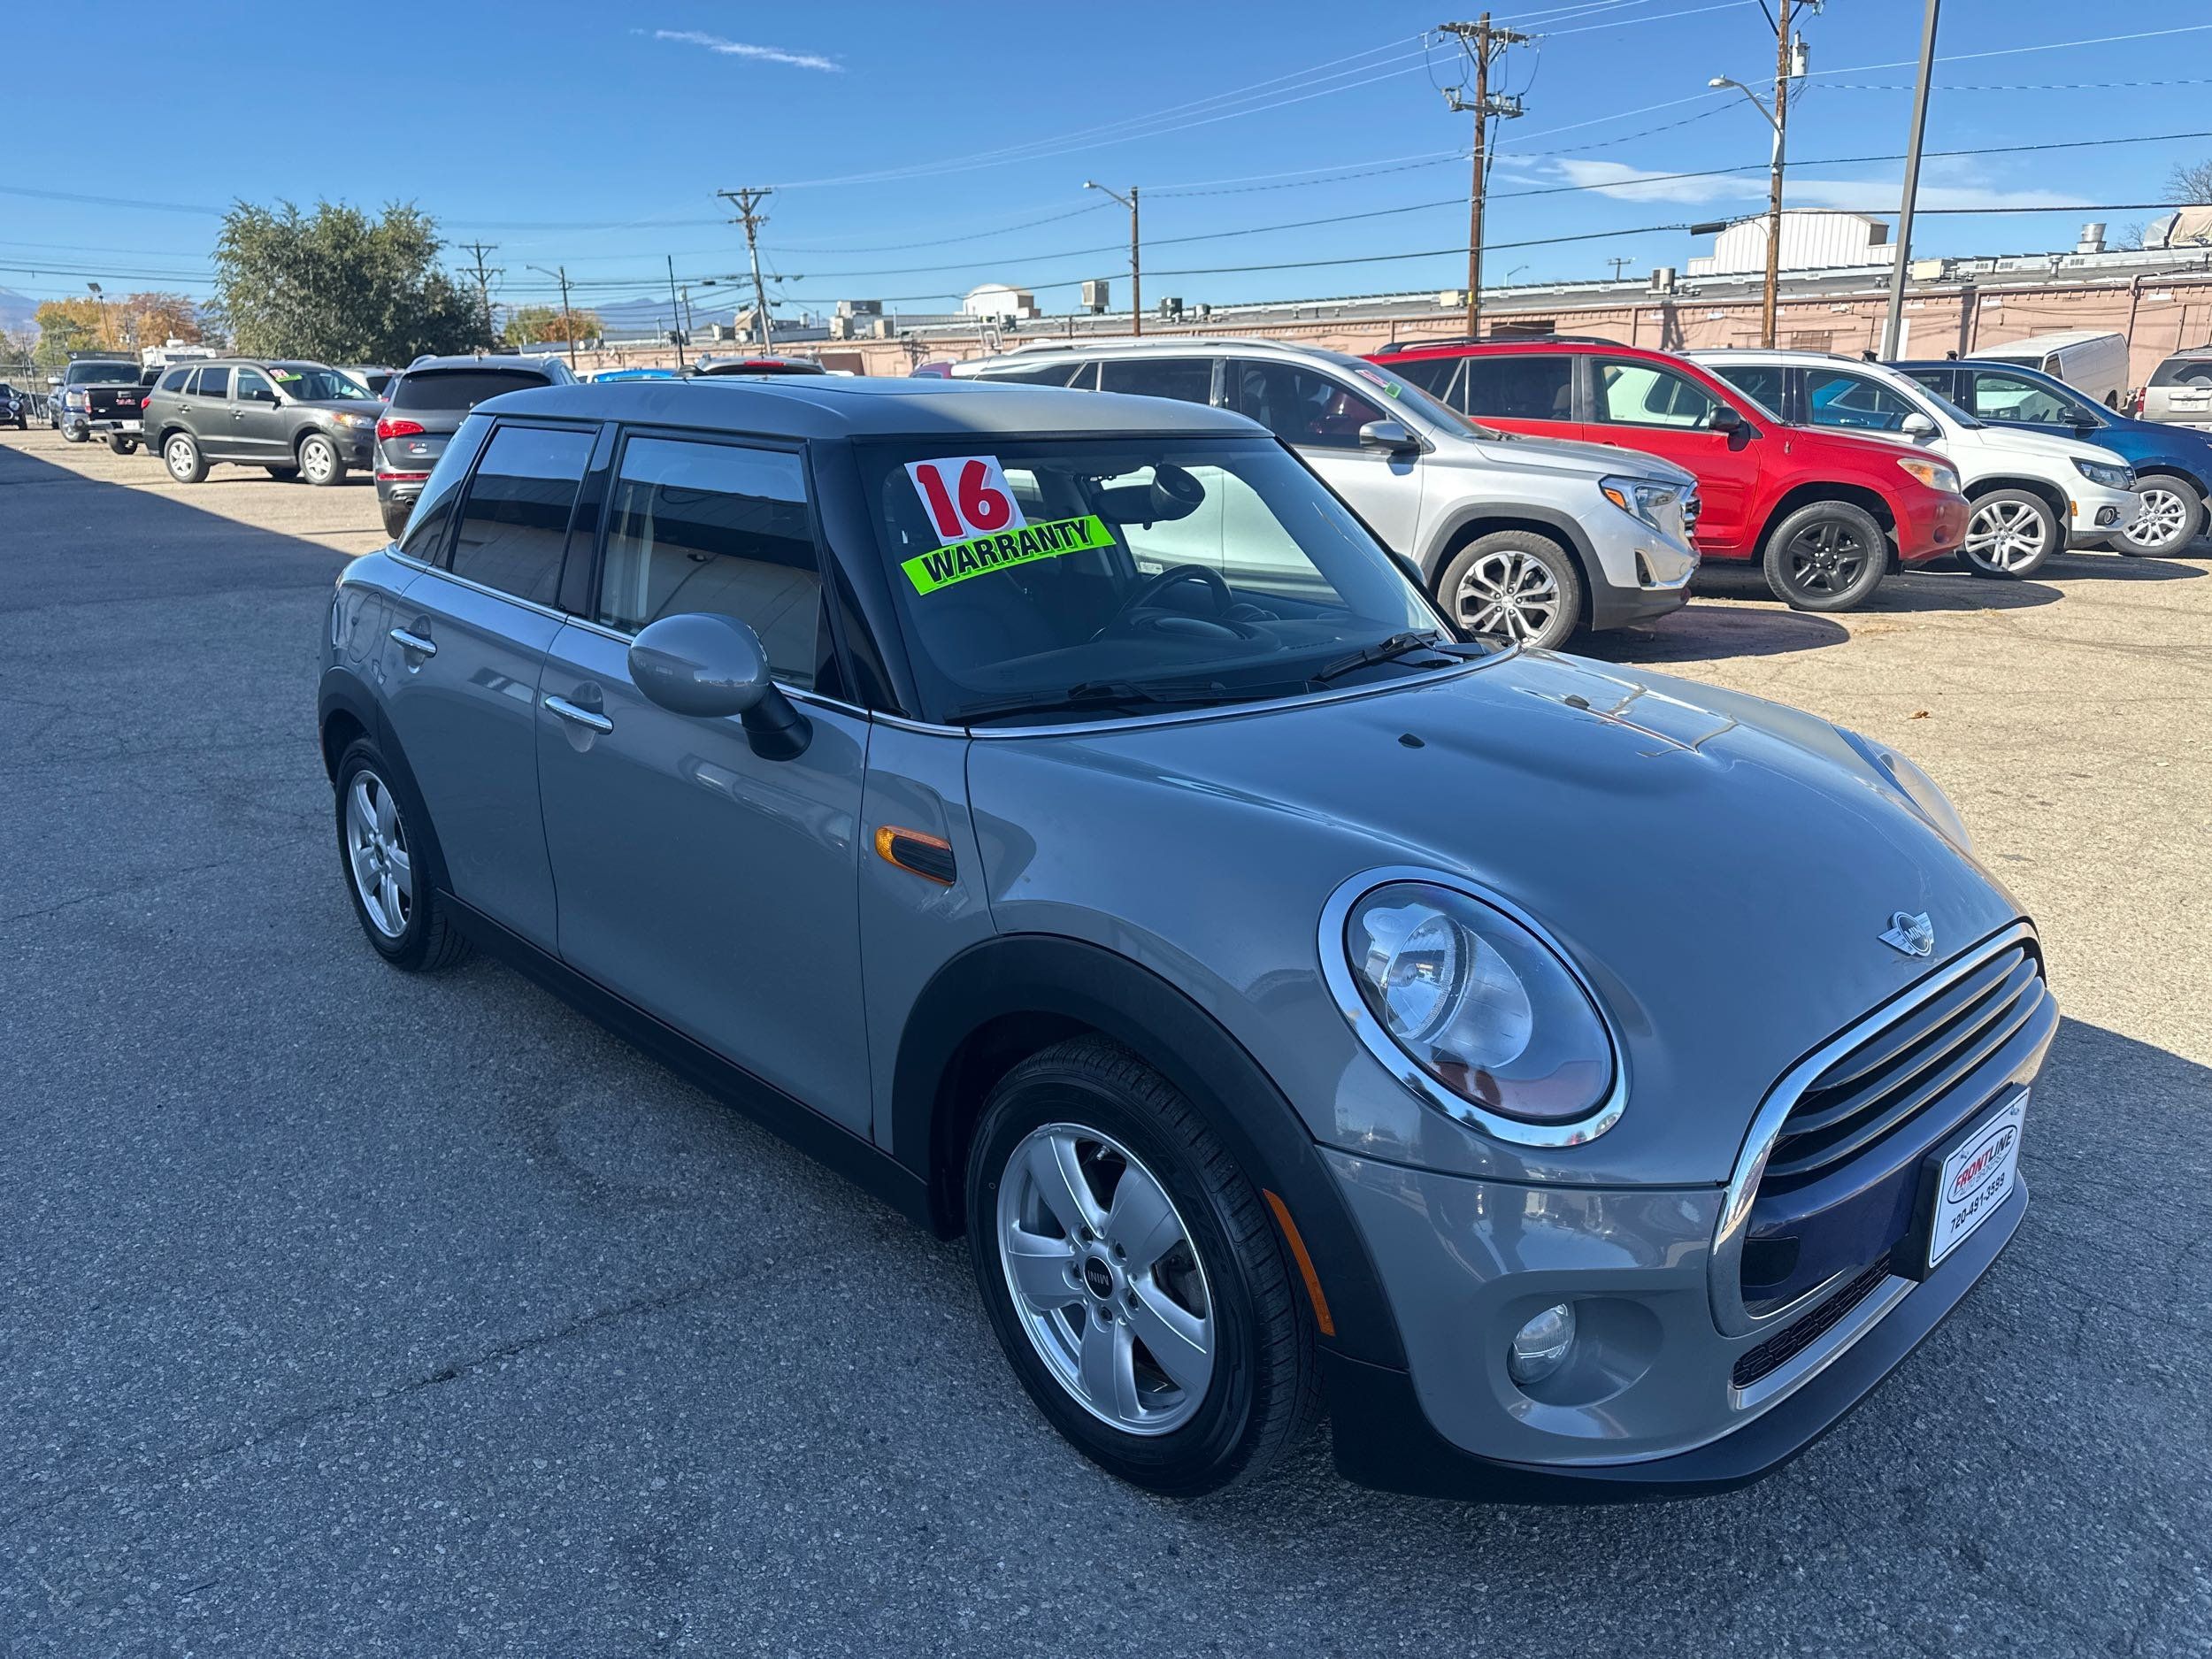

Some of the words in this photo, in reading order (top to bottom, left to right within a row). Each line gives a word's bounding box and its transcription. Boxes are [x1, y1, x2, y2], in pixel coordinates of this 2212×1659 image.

[916, 459, 1015, 538] 16
[921, 519, 1094, 584] WARRANTY
[1904, 925, 1925, 941] MINI
[1955, 1129, 2013, 1194] FRONTLINE
[1087, 1270, 1110, 1286] MINI
